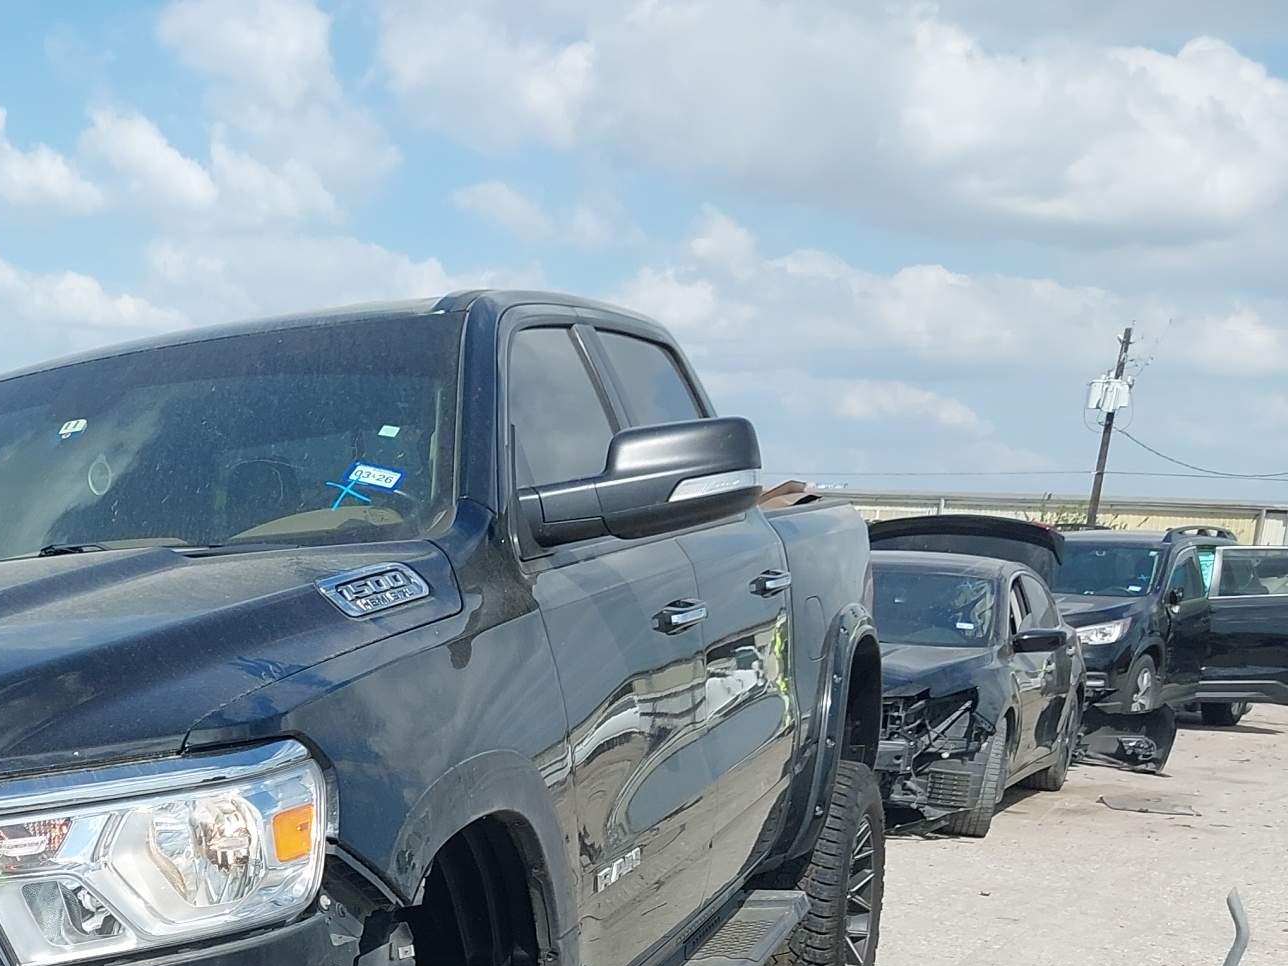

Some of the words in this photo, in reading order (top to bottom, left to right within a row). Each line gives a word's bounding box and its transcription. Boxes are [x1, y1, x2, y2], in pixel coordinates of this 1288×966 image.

[337, 570, 406, 602] 1500
[356, 592, 390, 611] HEMI
[597, 847, 641, 893] RAM
